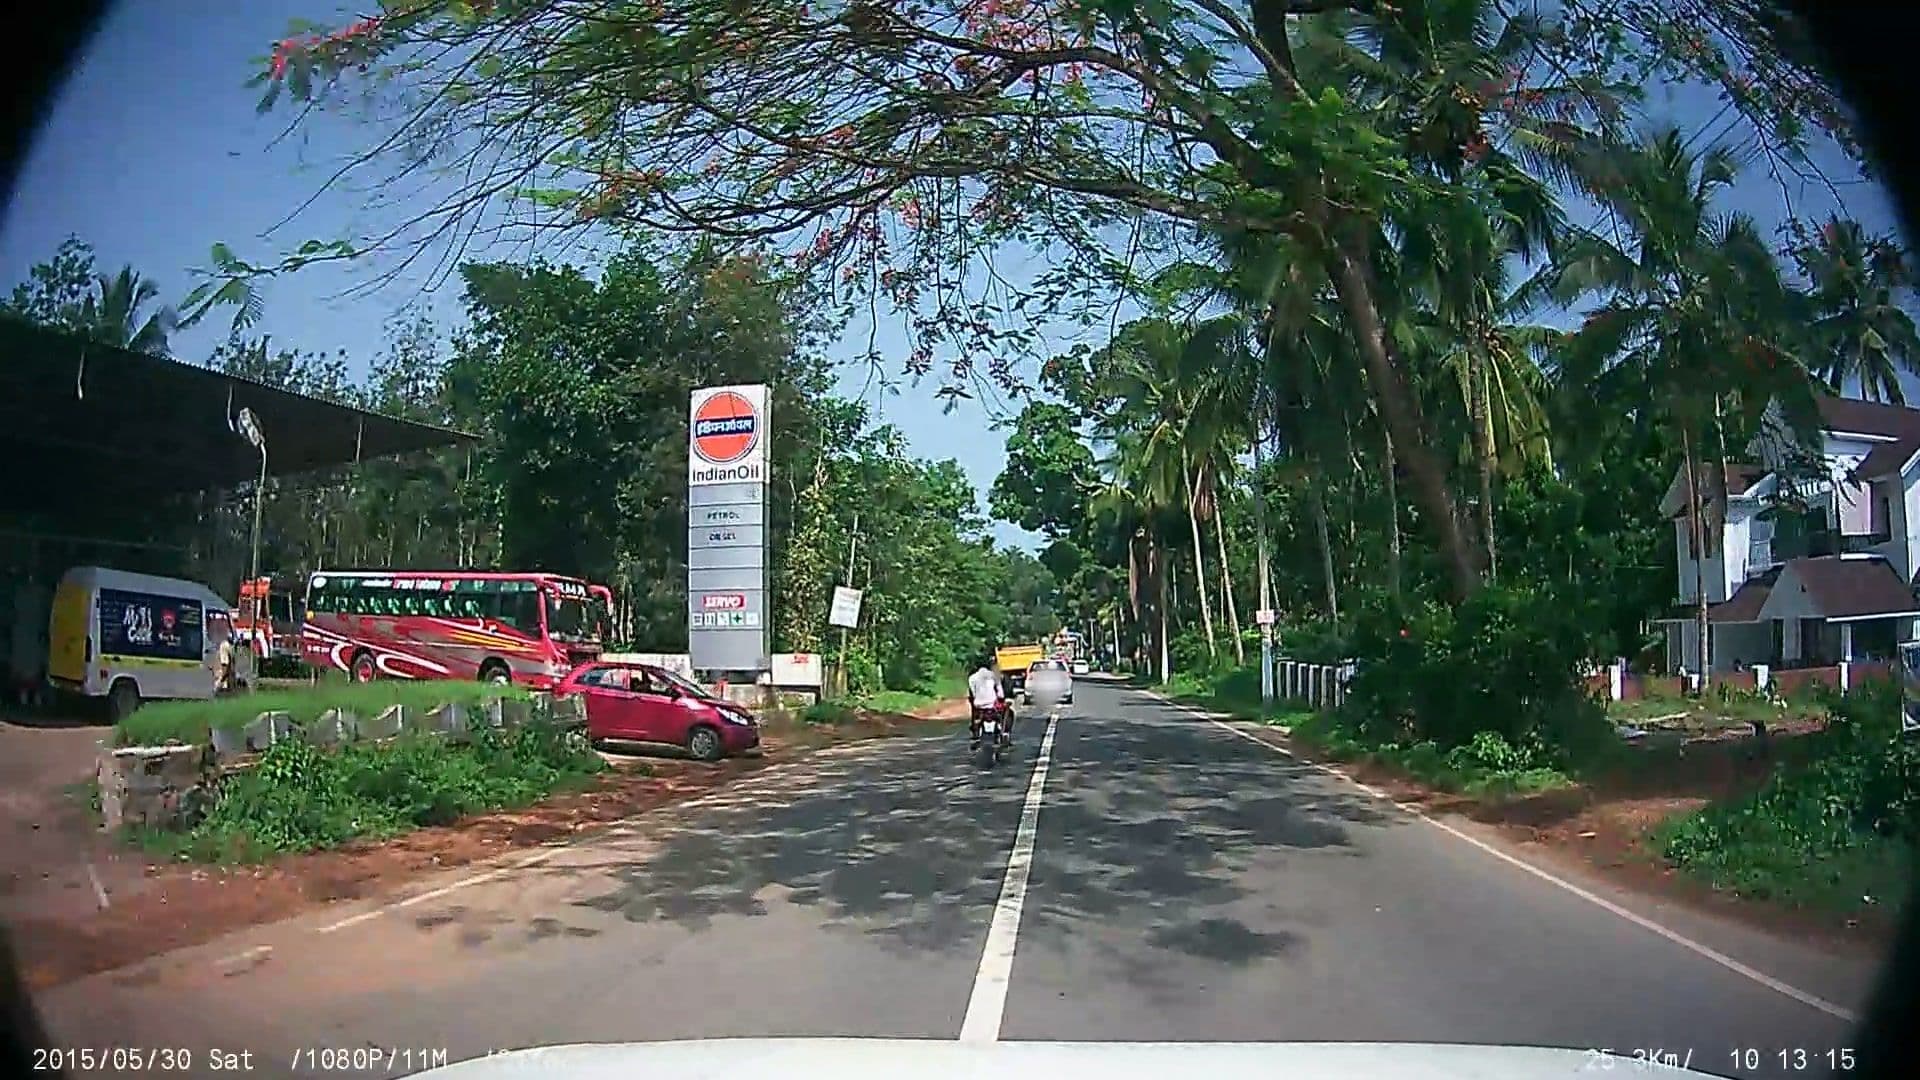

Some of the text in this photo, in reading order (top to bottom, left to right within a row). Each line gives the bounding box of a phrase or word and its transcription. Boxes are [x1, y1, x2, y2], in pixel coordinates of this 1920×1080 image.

[692, 463, 760, 482] IndianOil
[706, 510, 740, 520] PETROL
[704, 596, 741, 608] SERVO
